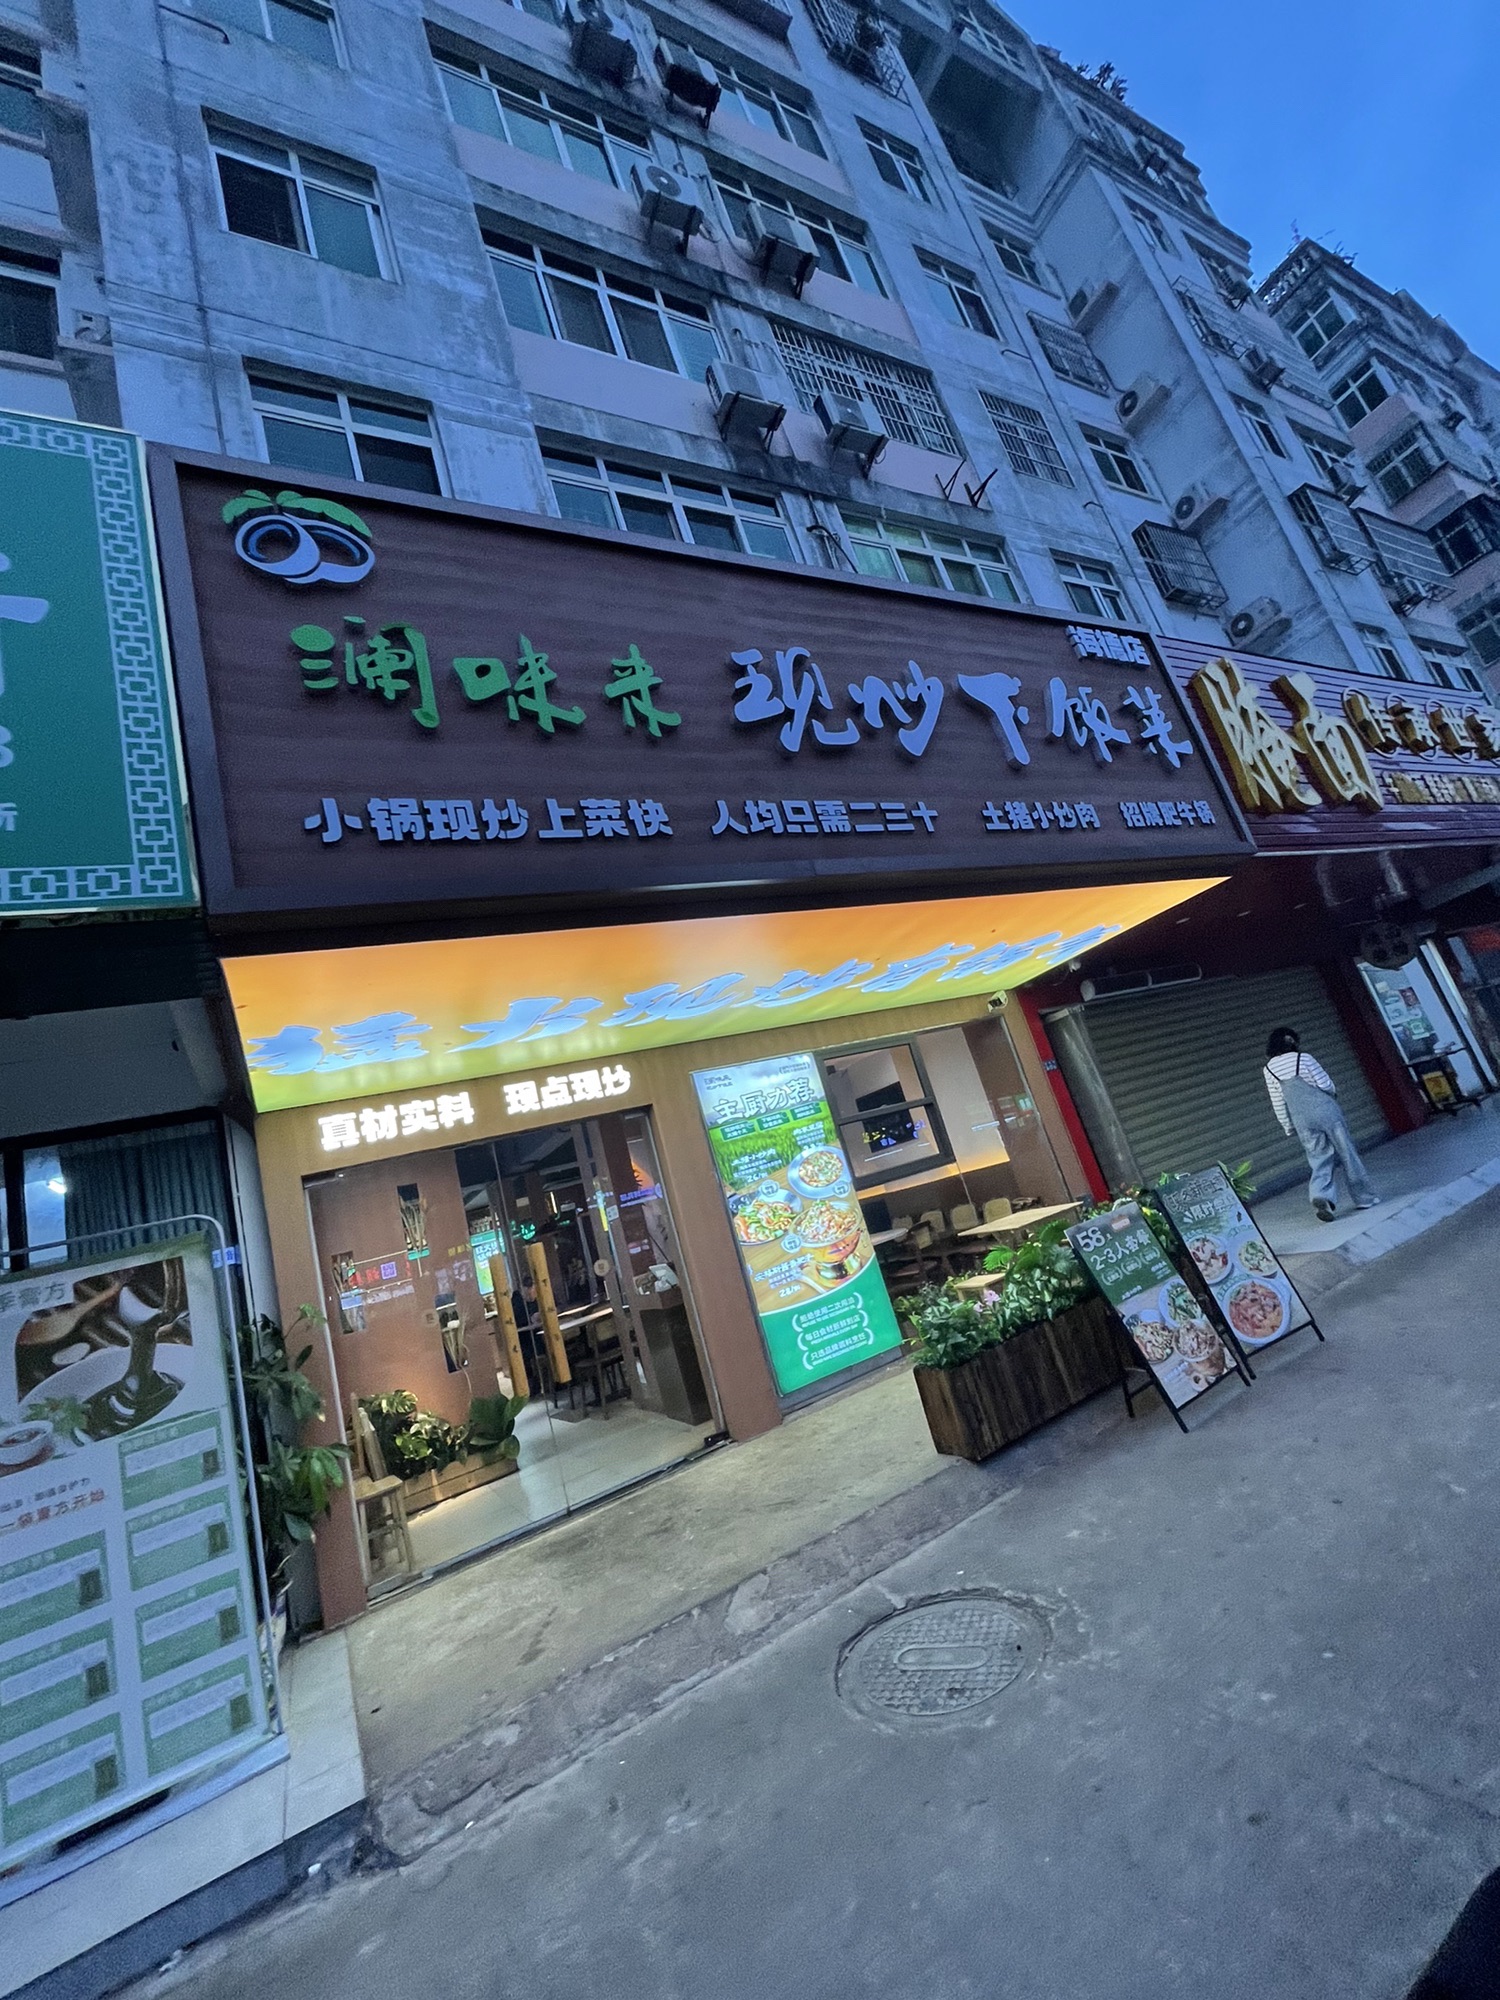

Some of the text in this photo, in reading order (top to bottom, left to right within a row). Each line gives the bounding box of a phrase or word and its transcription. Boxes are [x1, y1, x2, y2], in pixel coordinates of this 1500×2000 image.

[729, 646, 1194, 770] 现炒下饭菜
[303, 797, 1217, 844] 小锅现炒上菜快 人均只需二三十 土猪小炒肉 招牌肥牛锅
[317, 1064, 631, 1152] 真材实料 现点现炒
[713, 1076, 815, 1125] 主厨力荐
